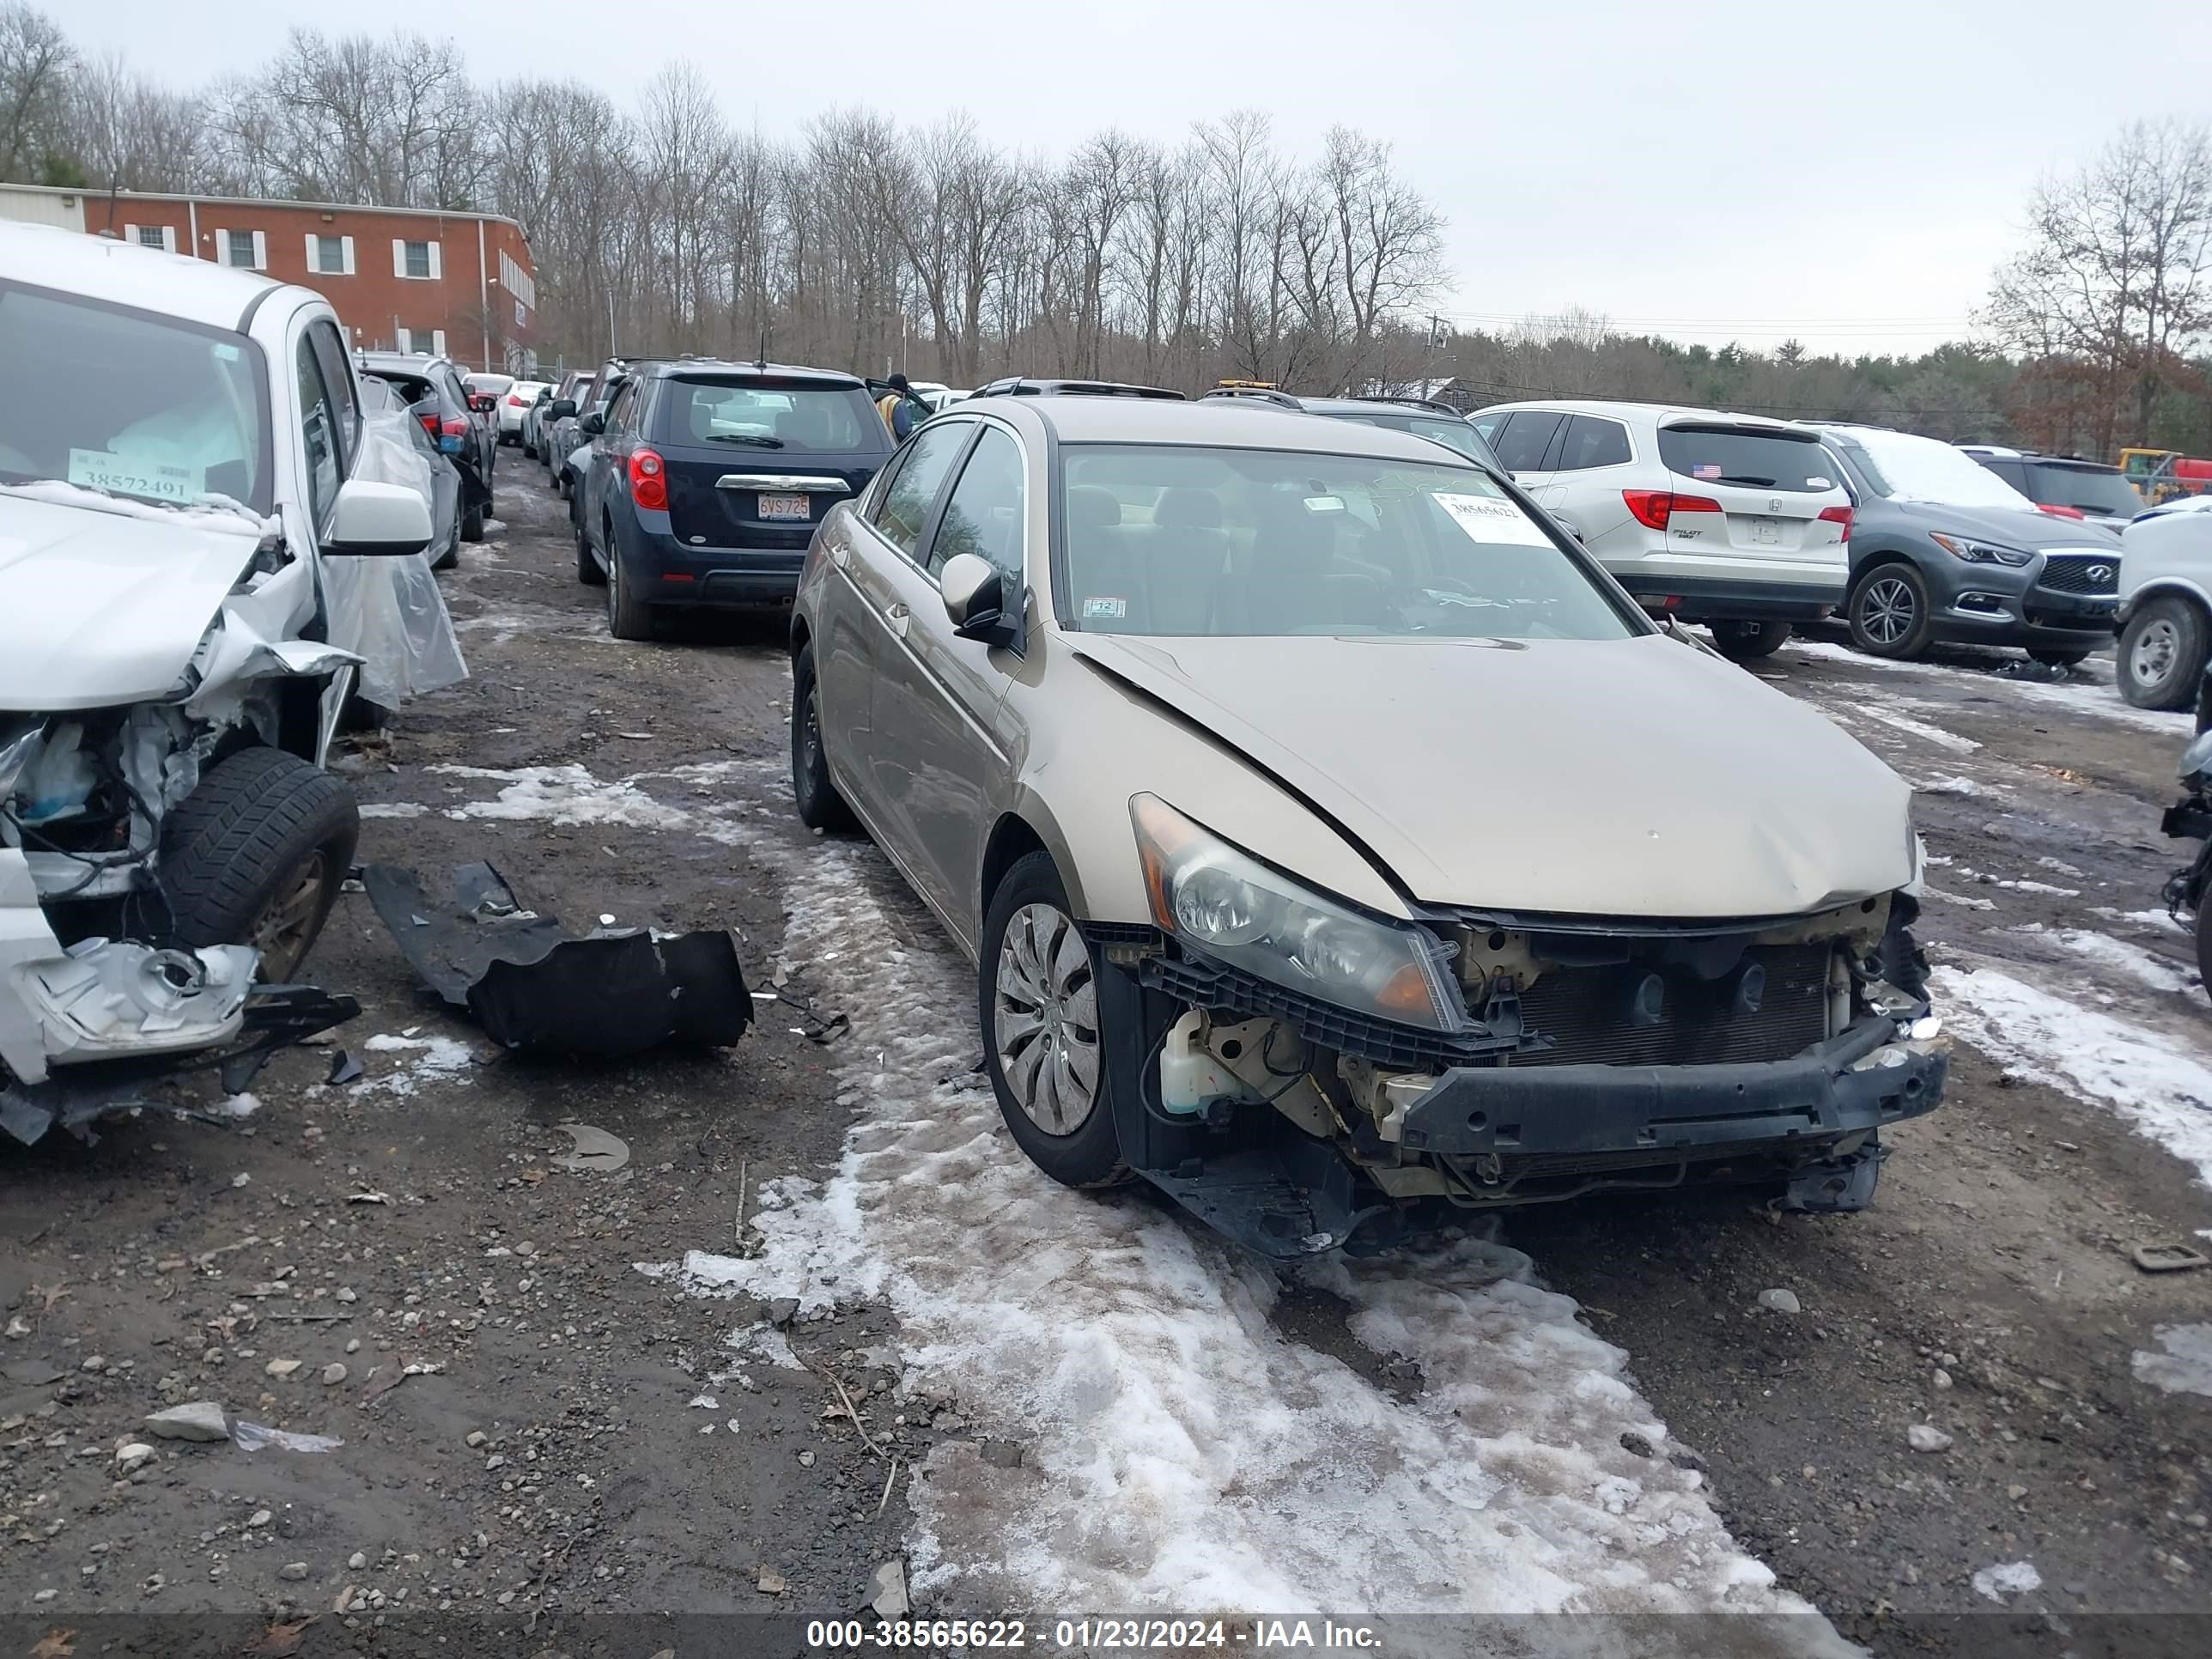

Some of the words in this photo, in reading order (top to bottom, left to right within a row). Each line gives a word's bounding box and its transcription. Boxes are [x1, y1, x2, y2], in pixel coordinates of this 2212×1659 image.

[86, 471, 185, 496] 38572491
[761, 500, 783, 514] 6VS
[786, 500, 808, 514] 725
[1451, 503, 1519, 519] 38565622
